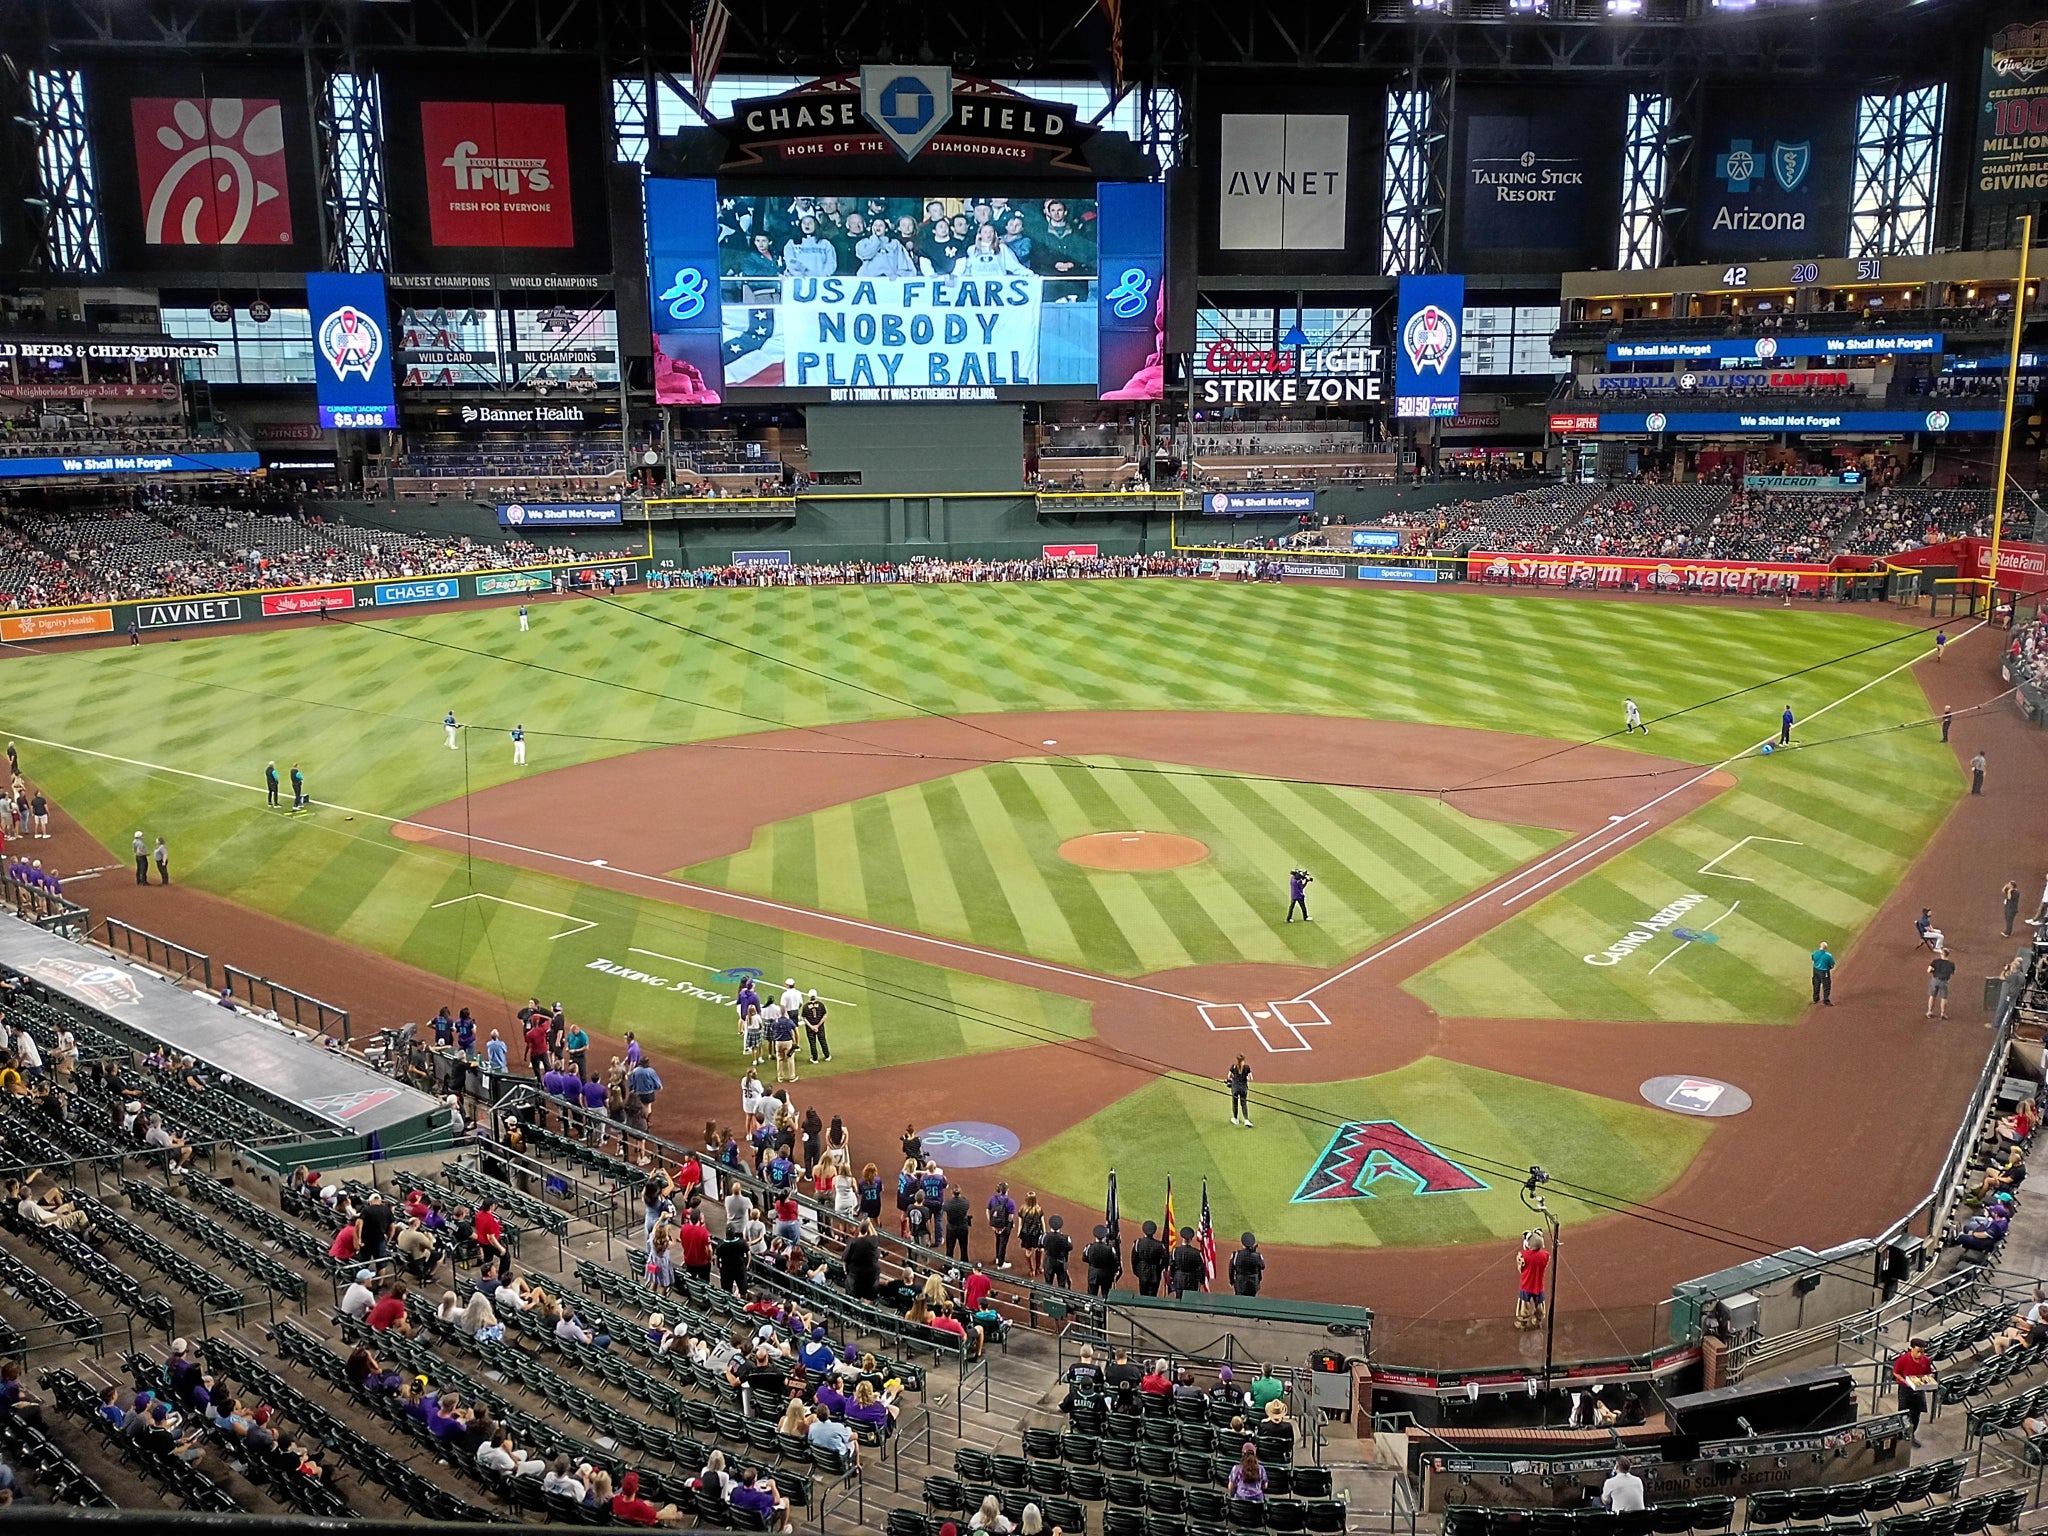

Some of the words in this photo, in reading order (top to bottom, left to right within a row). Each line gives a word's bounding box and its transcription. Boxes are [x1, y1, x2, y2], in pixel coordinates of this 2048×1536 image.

[746, 103, 854, 132] CHASE
[961, 105, 1064, 135] FIELD
[787, 143, 824, 155] HOME
[834, 142, 850, 152] OF
[859, 141, 884, 151] THE
[932, 142, 1027, 158] DIAMONDBACKS
[2009, 152, 2024, 161] IN
[503, 160, 543, 168] STORES
[1981, 162, 2048, 174] CHARITABLE
[1228, 171, 1339, 195] AVNET
[1980, 173, 2048, 191] GIVING
[450, 203, 479, 211] FRESH
[481, 203, 501, 211] FOR
[504, 204, 551, 212] EVERYONE
[1712, 206, 1806, 231] Arizona
[1723, 267, 1747, 285] 42
[1790, 264, 1819, 282] 20
[1857, 260, 1880, 280] 51
[389, 277, 402, 286] NL
[404, 277, 432, 286] WEST
[434, 277, 491, 286] CHAMPIONS
[510, 277, 542, 287] WORLD
[544, 277, 598, 287] CHAMPIONS
[793, 278, 877, 305] USA
[903, 279, 1030, 307] FEARS
[818, 312, 1000, 347] NOBODY
[1827, 340, 1844, 350] We
[1845, 339, 1874, 350] Shall
[1875, 338, 1895, 349] Not
[1896, 337, 1934, 350] Forget
[20, 344, 73, 357] BEERS
[76, 346, 86, 357] &
[88, 345, 217, 359] CHEESEBURGERS
[1205, 338, 1294, 373] Coors
[1299, 349, 1382, 372] LIGHT
[1617, 346, 1633, 356] We
[1634, 345, 1659, 356] Shall
[1660, 345, 1678, 355] Not
[1678, 344, 1711, 356] Forget
[418, 353, 444, 363] WILD
[446, 353, 472, 363] CARD
[525, 352, 538, 362] NL
[540, 352, 597, 362] CHAMPIONS
[797, 353, 904, 386] PLAY
[928, 351, 1030, 386] BALL
[1600, 374, 1678, 388] ESTRELLA
[1699, 374, 1767, 387] JALISCO
[1771, 372, 1848, 386] CANTINA
[16, 386, 68, 398] Neighborhood
[70, 386, 97, 398] Burger
[98, 386, 119, 396] Joint
[831, 388, 848, 400] BUT
[854, 388, 881, 400] THINK
[881, 388, 891, 400] IT
[891, 388, 911, 400] WAS
[911, 387, 958, 400] EXTREMELY
[959, 387, 998, 400] HEALING.
[1204, 378, 1297, 402] STRIKE
[1305, 377, 1381, 401] ZONE
[358, 405, 388, 413] JACKPOT
[480, 408, 541, 422] Banner
[543, 406, 585, 421] Health
[333, 412, 384, 427] $5,886
[1467, 417, 1500, 425] FITNESS
[1576, 421, 1598, 429] METER
[1740, 416, 1757, 425] We
[1758, 416, 1785, 426] Shall
[1786, 416, 1805, 426] Not
[1806, 415, 1841, 427] Forget
[270, 430, 309, 438] FITNESS
[62, 459, 83, 470] We
[84, 458, 115, 470] Shall
[116, 458, 135, 469] Not
[136, 457, 173, 471] Forget
[1757, 477, 1817, 488] SYNCRON
[1230, 498, 1245, 507] We
[1245, 497, 1265, 506] Shall
[1266, 497, 1281, 506] Not
[1282, 496, 1310, 508] Forget
[528, 510, 543, 519] We
[544, 509, 566, 519] Shall
[567, 509, 585, 518] Not
[585, 507, 616, 519] Forget
[660, 559, 675, 567] 413
[1283, 564, 1309, 575] Banner
[1311, 565, 1340, 576] Health
[1381, 569, 1411, 578] Spectrum
[1439, 572, 1454, 580] 374
[385, 586, 436, 600] CHASE
[358, 598, 374, 607] 374
[150, 601, 230, 625] AVNET
[38, 619, 67, 630] Dignity
[68, 615, 95, 625] Health
[772, 1169, 783, 1181] 26
[865, 1188, 878, 1200] 33
[925, 1186, 939, 1197] 26
[1740, 1469, 1792, 1483] SECTION
